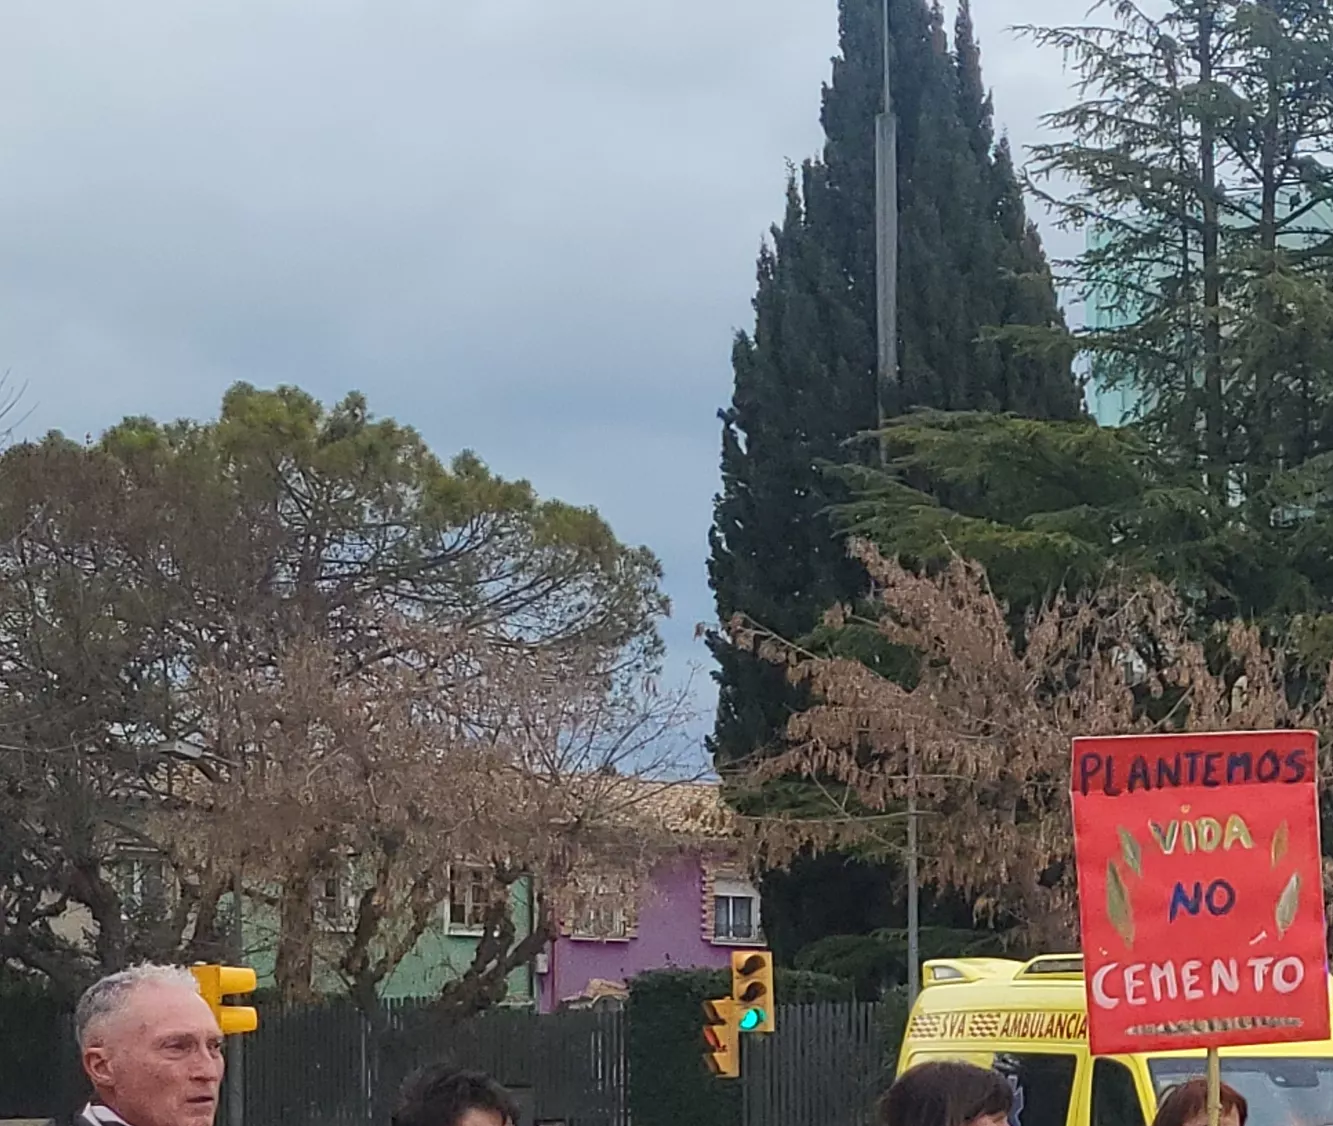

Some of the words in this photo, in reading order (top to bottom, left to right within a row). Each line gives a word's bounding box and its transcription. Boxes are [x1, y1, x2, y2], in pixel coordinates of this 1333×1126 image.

[1078, 748, 1308, 797] PLANTEMOS
[1168, 878, 1237, 924] NO
[1090, 956, 1305, 1010] CEMENTO
[940, 1013, 967, 1038] SVA
[1000, 1012, 1088, 1039] AMBULANCIA
